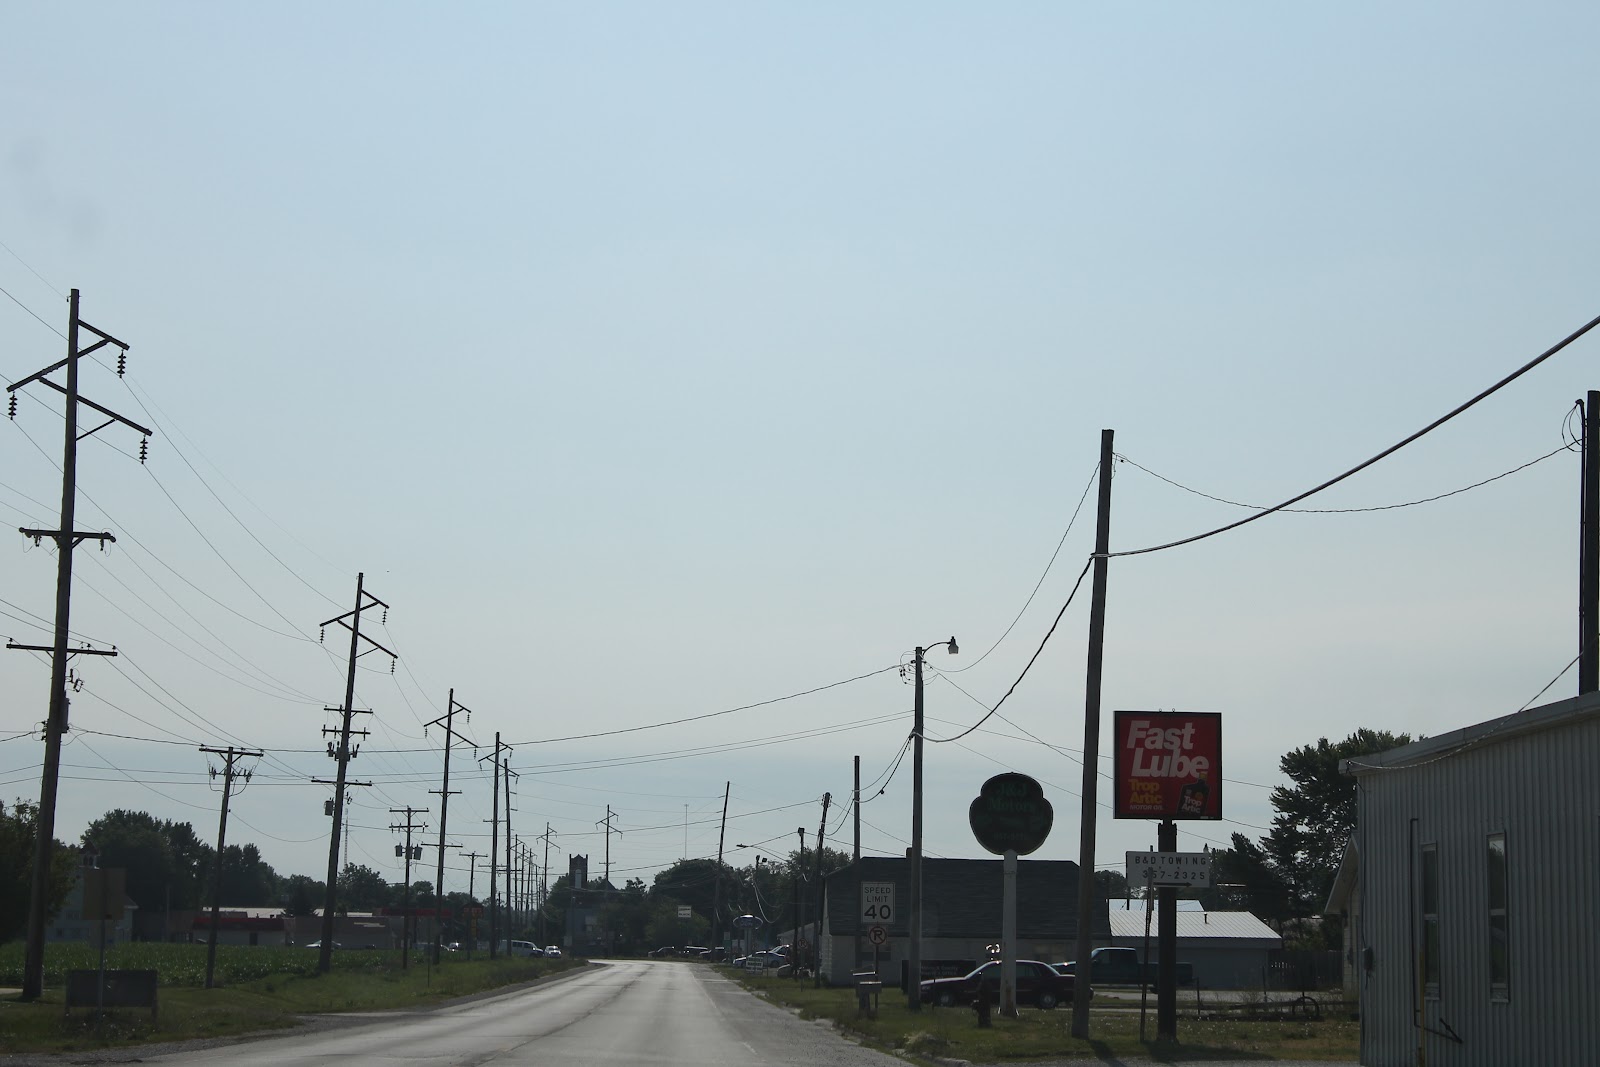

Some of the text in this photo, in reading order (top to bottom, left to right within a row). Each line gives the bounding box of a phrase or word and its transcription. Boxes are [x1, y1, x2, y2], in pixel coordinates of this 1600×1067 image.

[1127, 720, 1195, 750] Fast
[1131, 747, 1209, 778] Lube
[1128, 779, 1160, 793] Trop
[1129, 792, 1163, 804] Artic
[1184, 795, 1202, 806] Trop
[1181, 803, 1201, 814] Artic
[1135, 856, 1206, 866] B&D TOWING
[1142, 870, 1205, 880] 357-2325
[864, 904, 891, 919] 40
